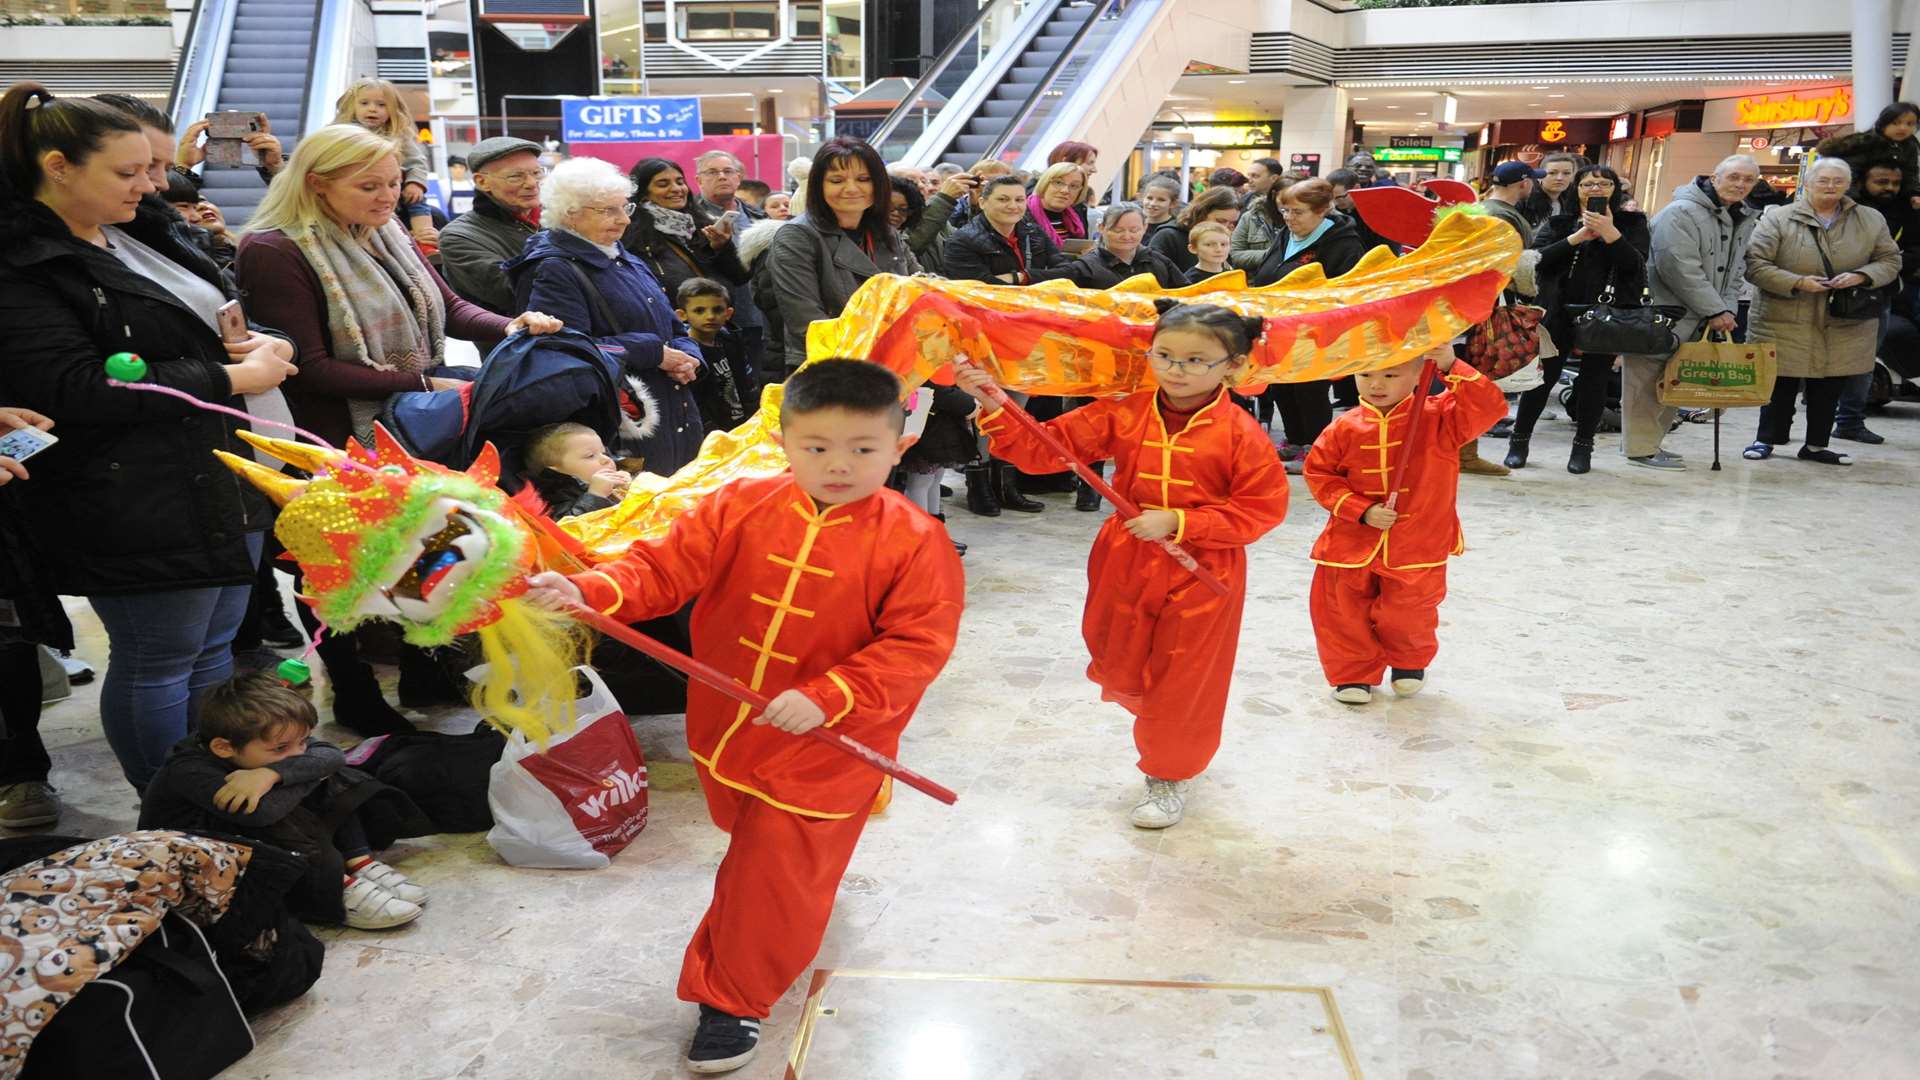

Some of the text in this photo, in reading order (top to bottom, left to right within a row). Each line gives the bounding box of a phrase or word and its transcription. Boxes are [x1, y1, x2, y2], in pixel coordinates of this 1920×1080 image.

[1736, 88, 1850, 125] Sainsbury's
[579, 104, 662, 125] GIFTS
[1391, 137, 1431, 147] Toilets
[1388, 153, 1439, 161] CLEANERS
[1680, 368, 1752, 383] Green Bag
